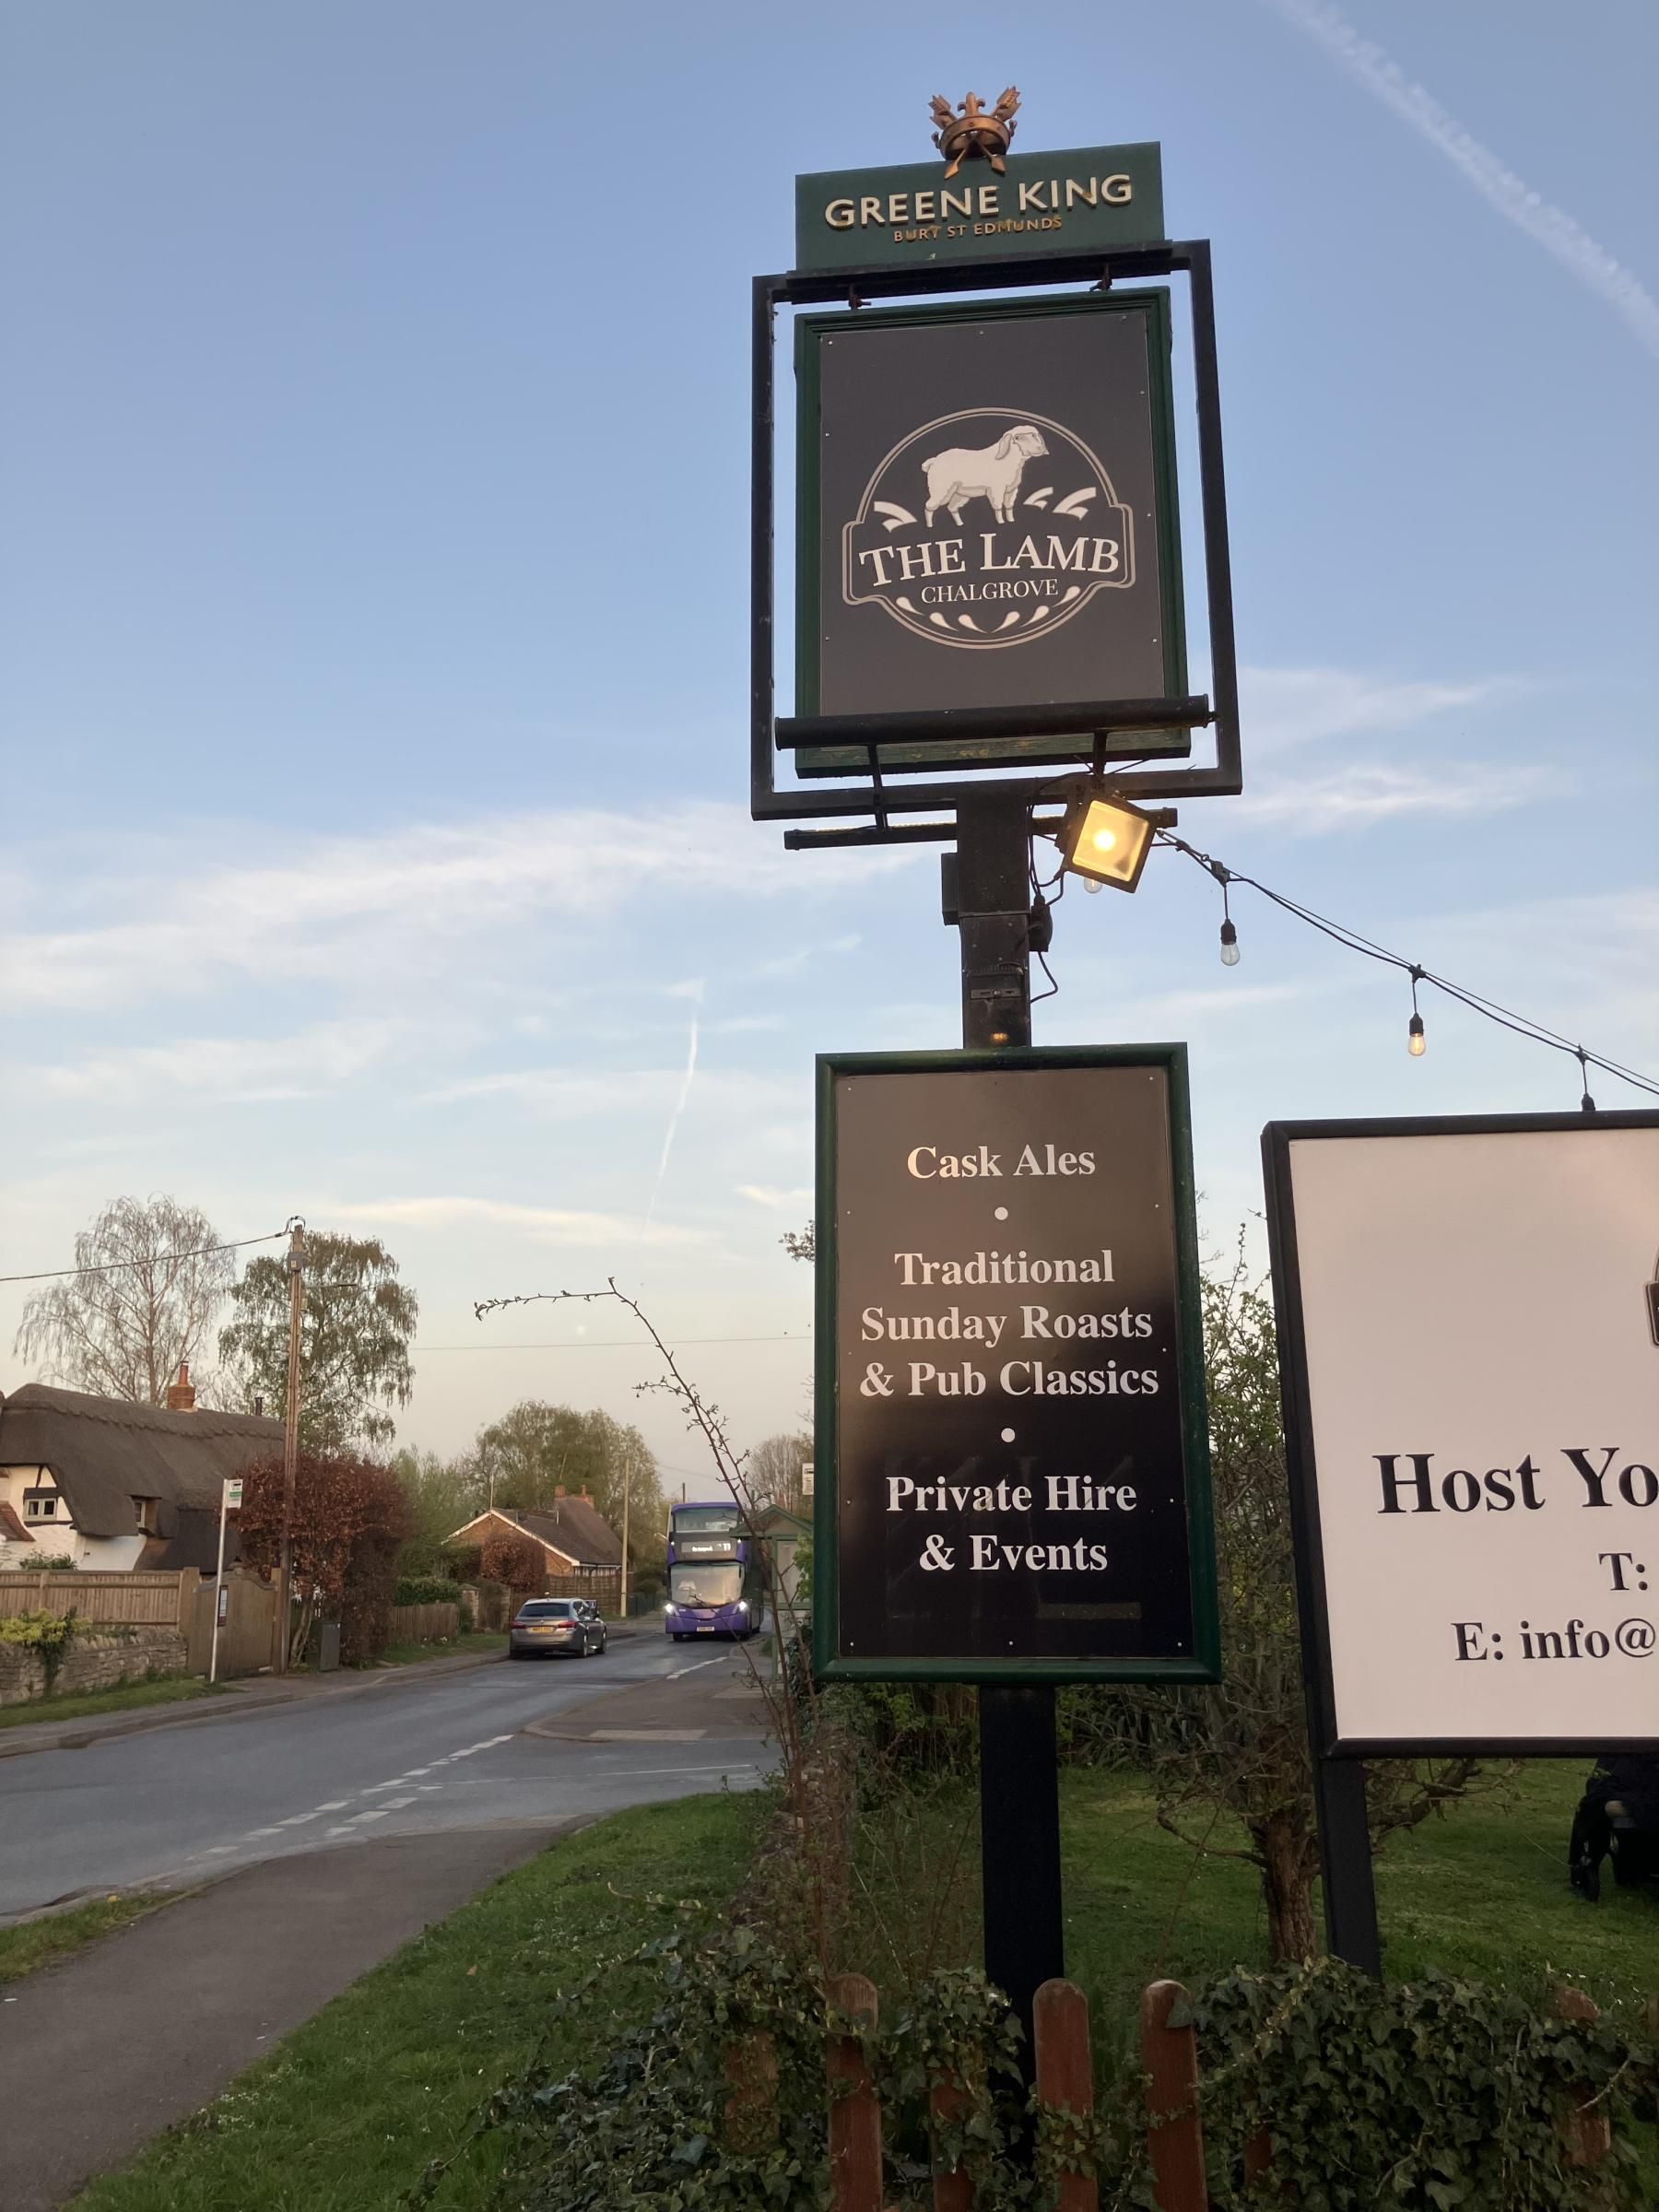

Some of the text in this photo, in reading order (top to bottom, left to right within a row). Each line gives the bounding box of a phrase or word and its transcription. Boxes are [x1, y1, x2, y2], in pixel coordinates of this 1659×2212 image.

[824, 173, 1134, 229] GREENE KING
[893, 213, 1063, 243] BURY ST EDMUNDS
[858, 533, 1120, 588] THE LAMB
[921, 579, 1059, 604] CHALGROVE
[907, 1144, 1096, 1179] Cask Ales
[894, 1249, 1115, 1286] Traditional
[862, 1305, 1153, 1347] Sunday Roasts
[859, 1359, 1159, 1397] & Pub Classics
[886, 1475, 1136, 1512] Private Hire
[1371, 1446, 1659, 1514] Host Yo
[919, 1534, 1108, 1572] & Events
[1598, 1552, 1650, 1593] T:
[1451, 1618, 1657, 1663] E: info@
